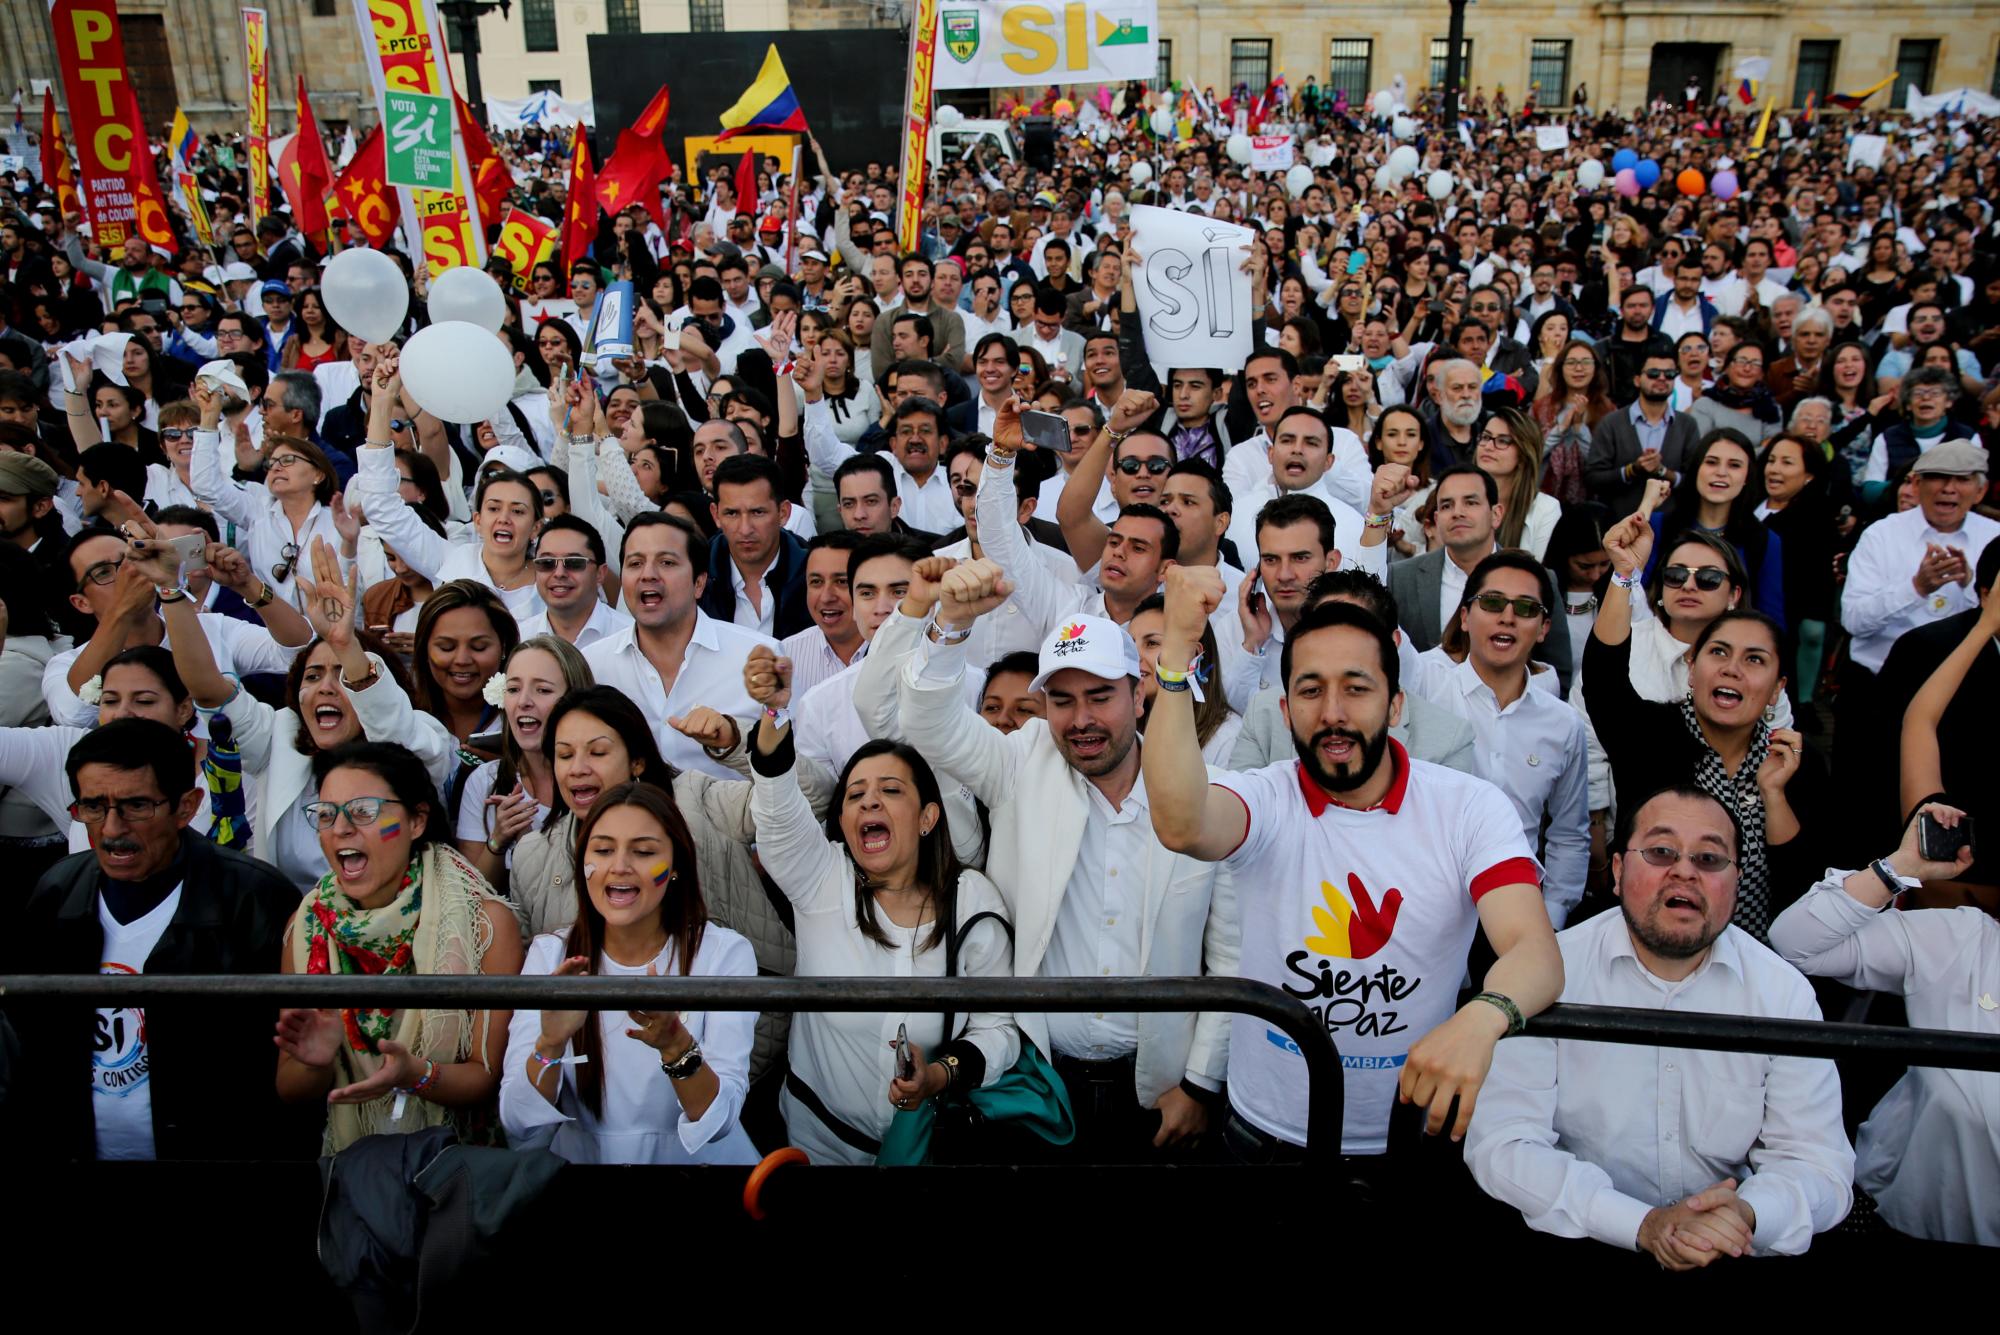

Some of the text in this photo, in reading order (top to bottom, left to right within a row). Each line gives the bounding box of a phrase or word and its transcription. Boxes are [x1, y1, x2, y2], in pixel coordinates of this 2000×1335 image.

[389, 37, 418, 52] PTC
[71, 9, 133, 172] PTC
[391, 99, 417, 113] VOTA
[91, 178, 126, 192] PARTIDO
[95, 192, 134, 207] del TRABA
[427, 200, 455, 214] PTC
[97, 210, 108, 222] de
[1281, 950, 1422, 1004] Siente
